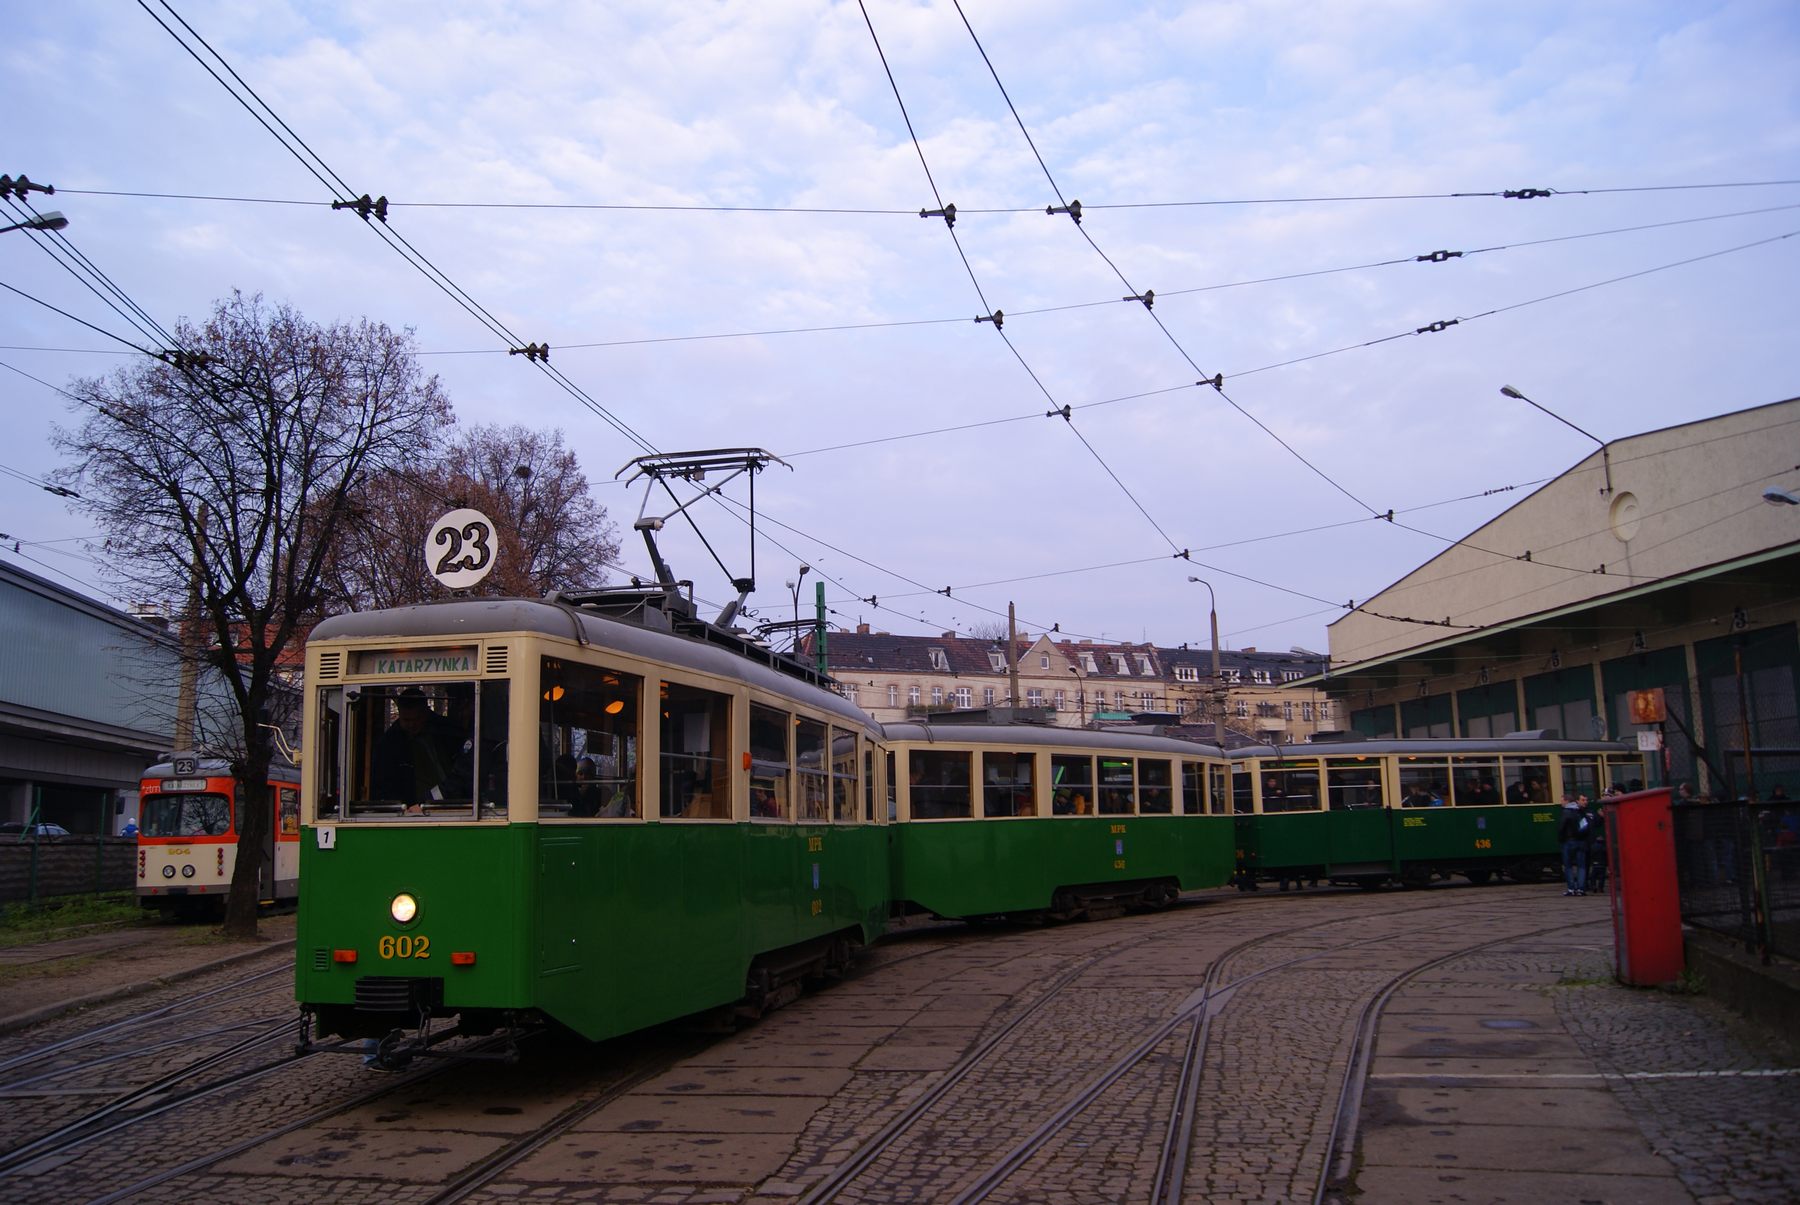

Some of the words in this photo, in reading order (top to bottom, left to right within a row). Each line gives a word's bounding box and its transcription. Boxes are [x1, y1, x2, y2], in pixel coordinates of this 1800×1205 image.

[436, 522, 491, 575] 23
[378, 656, 470, 674] KATARZYNKA
[178, 761, 193, 772] 23
[323, 831, 330, 844] 1
[808, 836, 822, 852] MPK
[379, 935, 430, 960] 602
